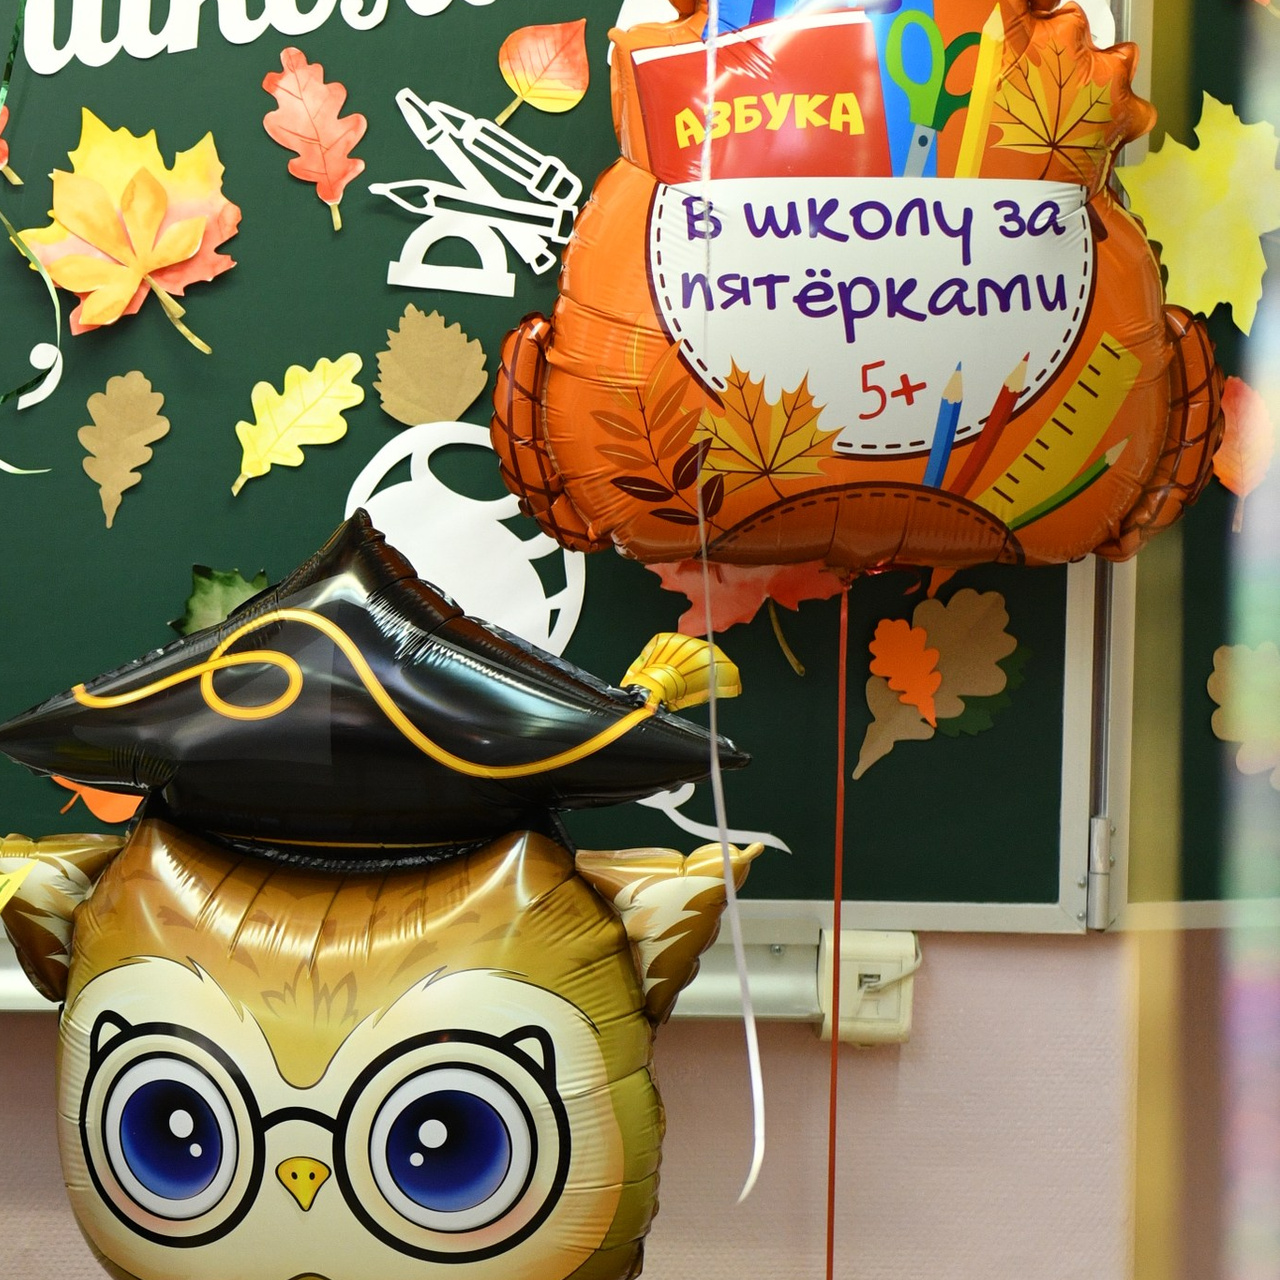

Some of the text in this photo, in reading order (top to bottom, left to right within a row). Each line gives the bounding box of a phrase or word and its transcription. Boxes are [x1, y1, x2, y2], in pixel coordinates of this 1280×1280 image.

[674, 92, 866, 149] АЗБУКА
[682, 195, 1067, 266] В школу за
[681, 269, 1068, 344] пятёрками
[858, 359, 927, 420] 5+
